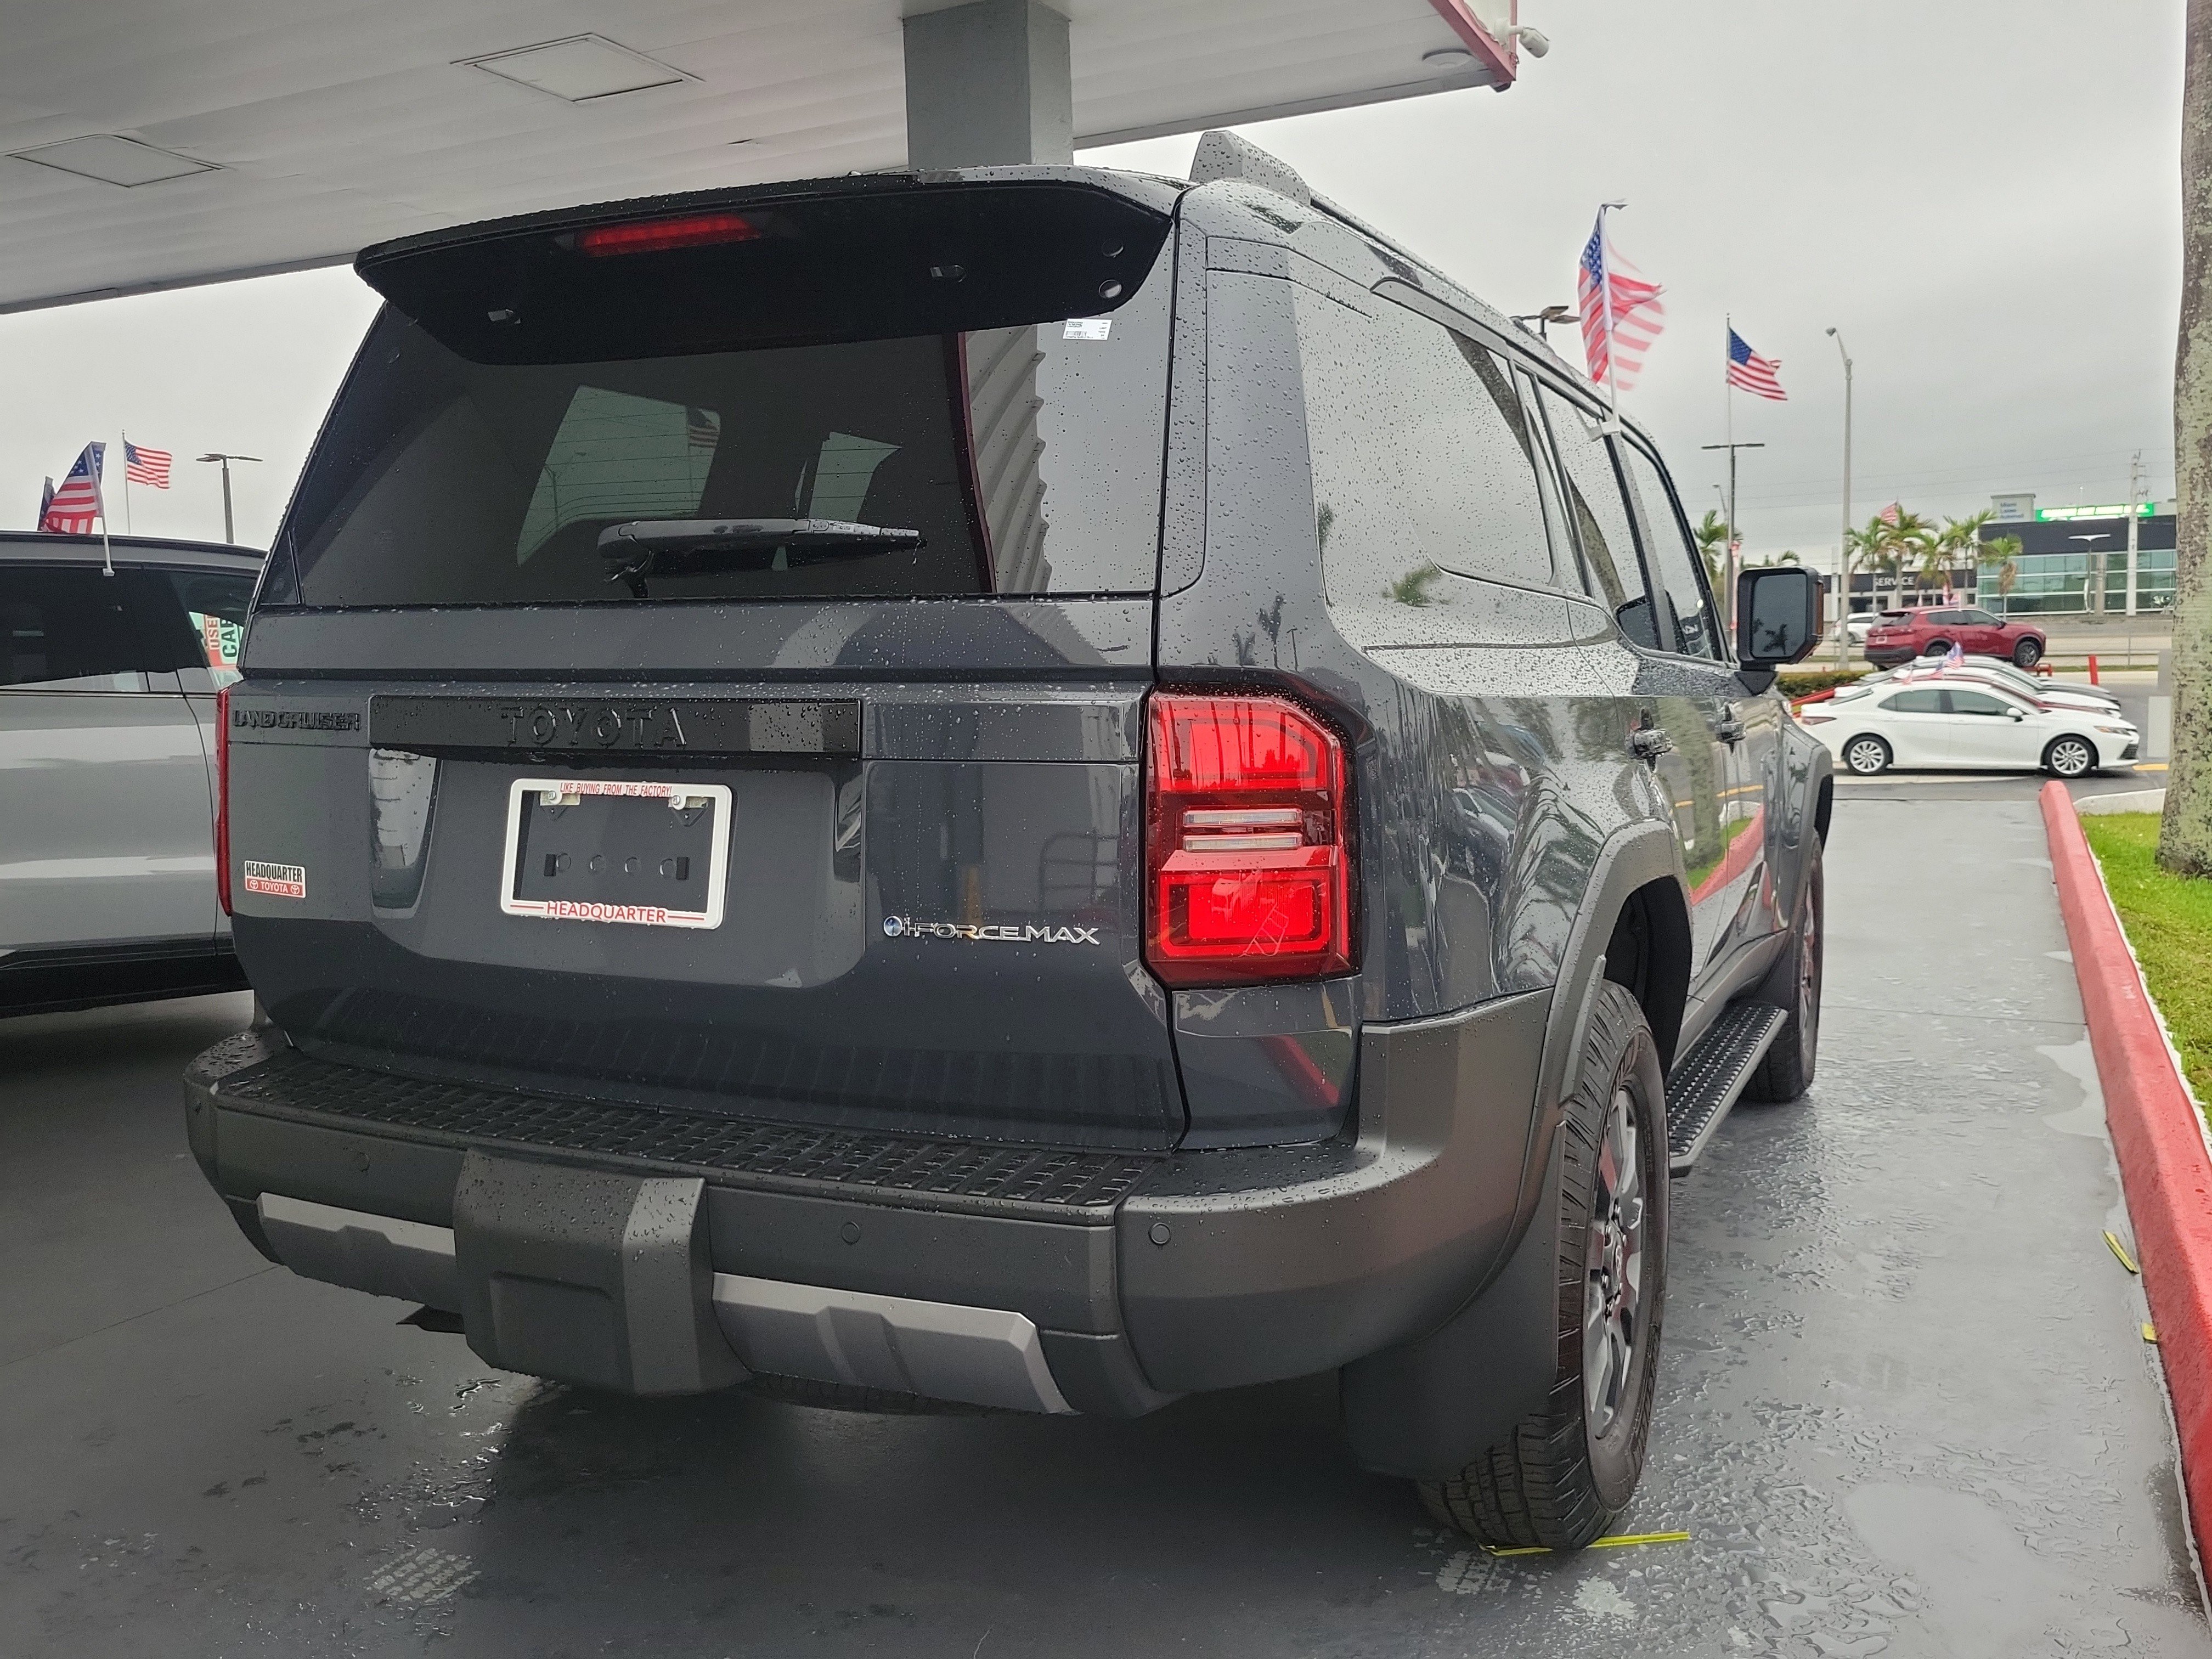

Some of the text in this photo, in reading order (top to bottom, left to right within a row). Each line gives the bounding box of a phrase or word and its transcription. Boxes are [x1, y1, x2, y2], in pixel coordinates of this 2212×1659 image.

[1874, 577, 1915, 586] SERVCE
[207, 616, 220, 648] USE
[278, 712, 360, 731] CRUISER
[500, 707, 686, 748] TOYOTA
[560, 783, 672, 796] LIKE BUYING FROM THE FACTORY!
[246, 862, 302, 883] HEADQUARTER
[261, 882, 289, 893] TOYOTA
[547, 902, 666, 923] HEADQUARTER
